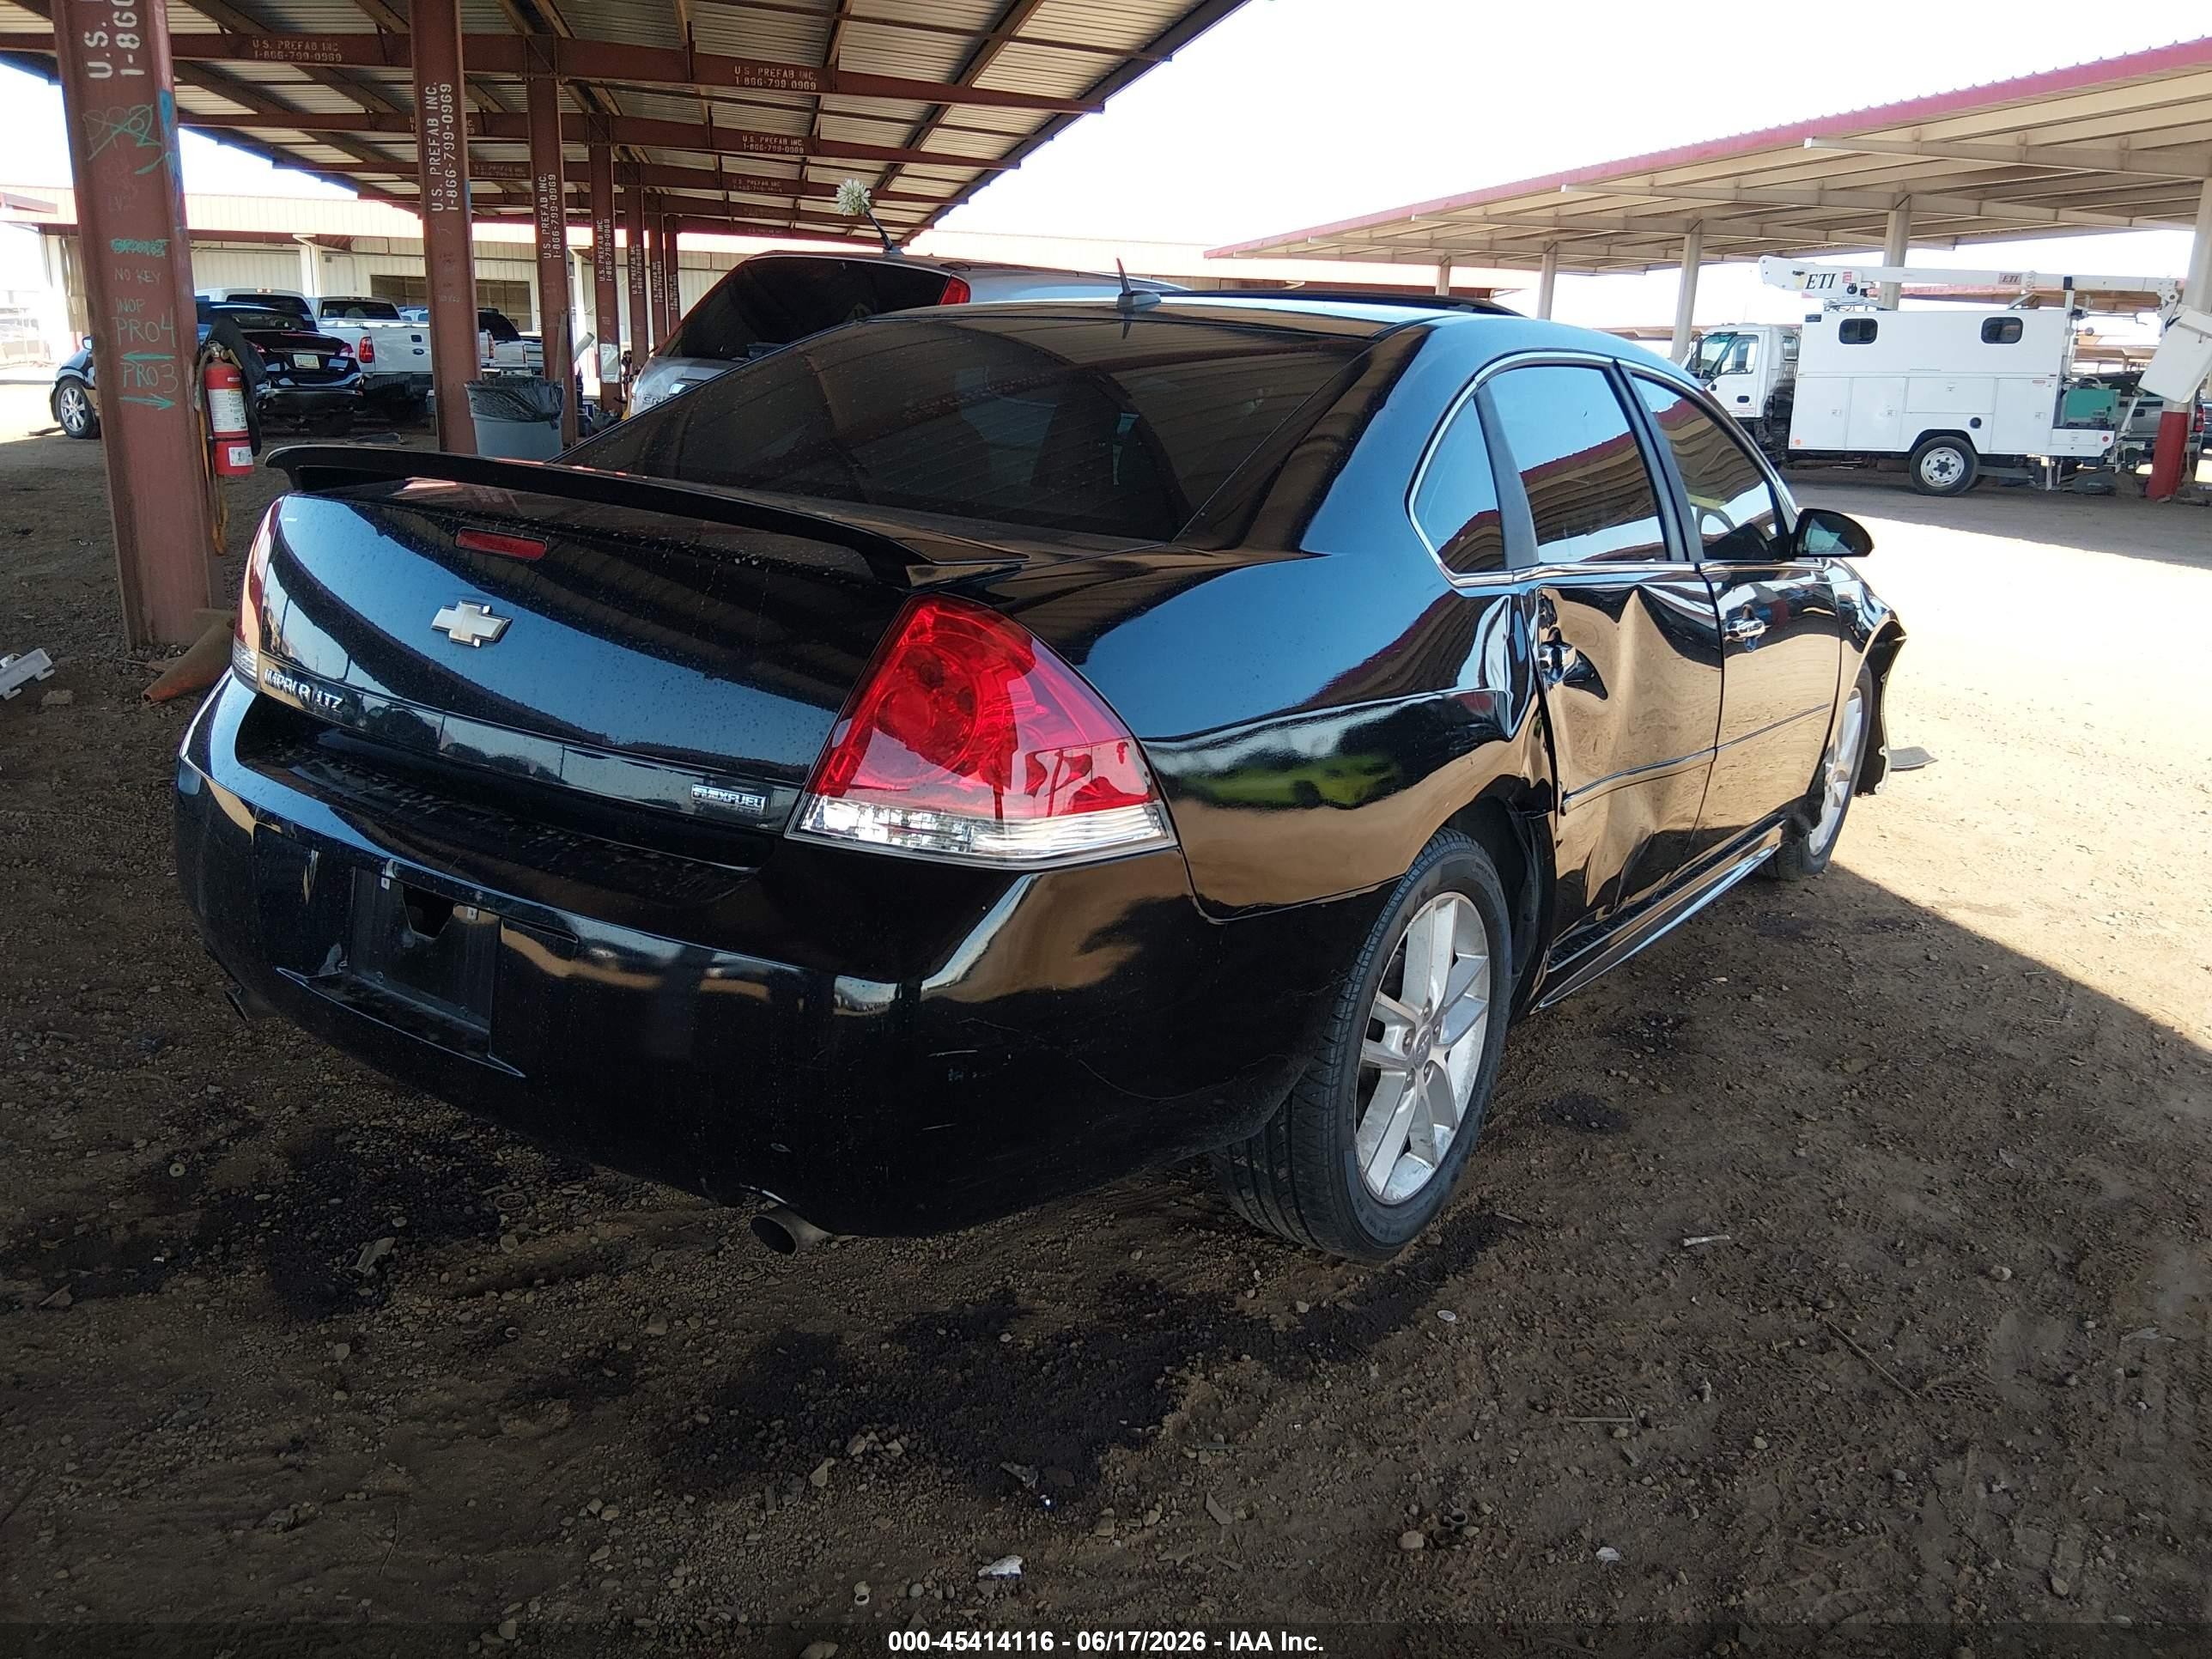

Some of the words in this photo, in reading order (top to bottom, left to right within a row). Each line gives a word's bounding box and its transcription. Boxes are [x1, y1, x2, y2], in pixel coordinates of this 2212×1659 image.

[84, 21, 113, 78] U.S.
[111, 0, 145, 76] 1-86
[277, 40, 318, 51] PREFAB
[757, 68, 795, 79] PREFAB
[425, 82, 439, 110] INC.
[427, 118, 442, 175] PREFAB
[439, 83, 459, 211] 1-866-799-0969
[430, 184, 445, 212] U.S.
[539, 197, 550, 235] PREFAB
[114, 268, 131, 282] NO
[136, 268, 161, 284] KEY
[1805, 273, 1838, 290] ETI
[115, 297, 146, 313] INOP
[316, 690, 344, 714] LTZ
